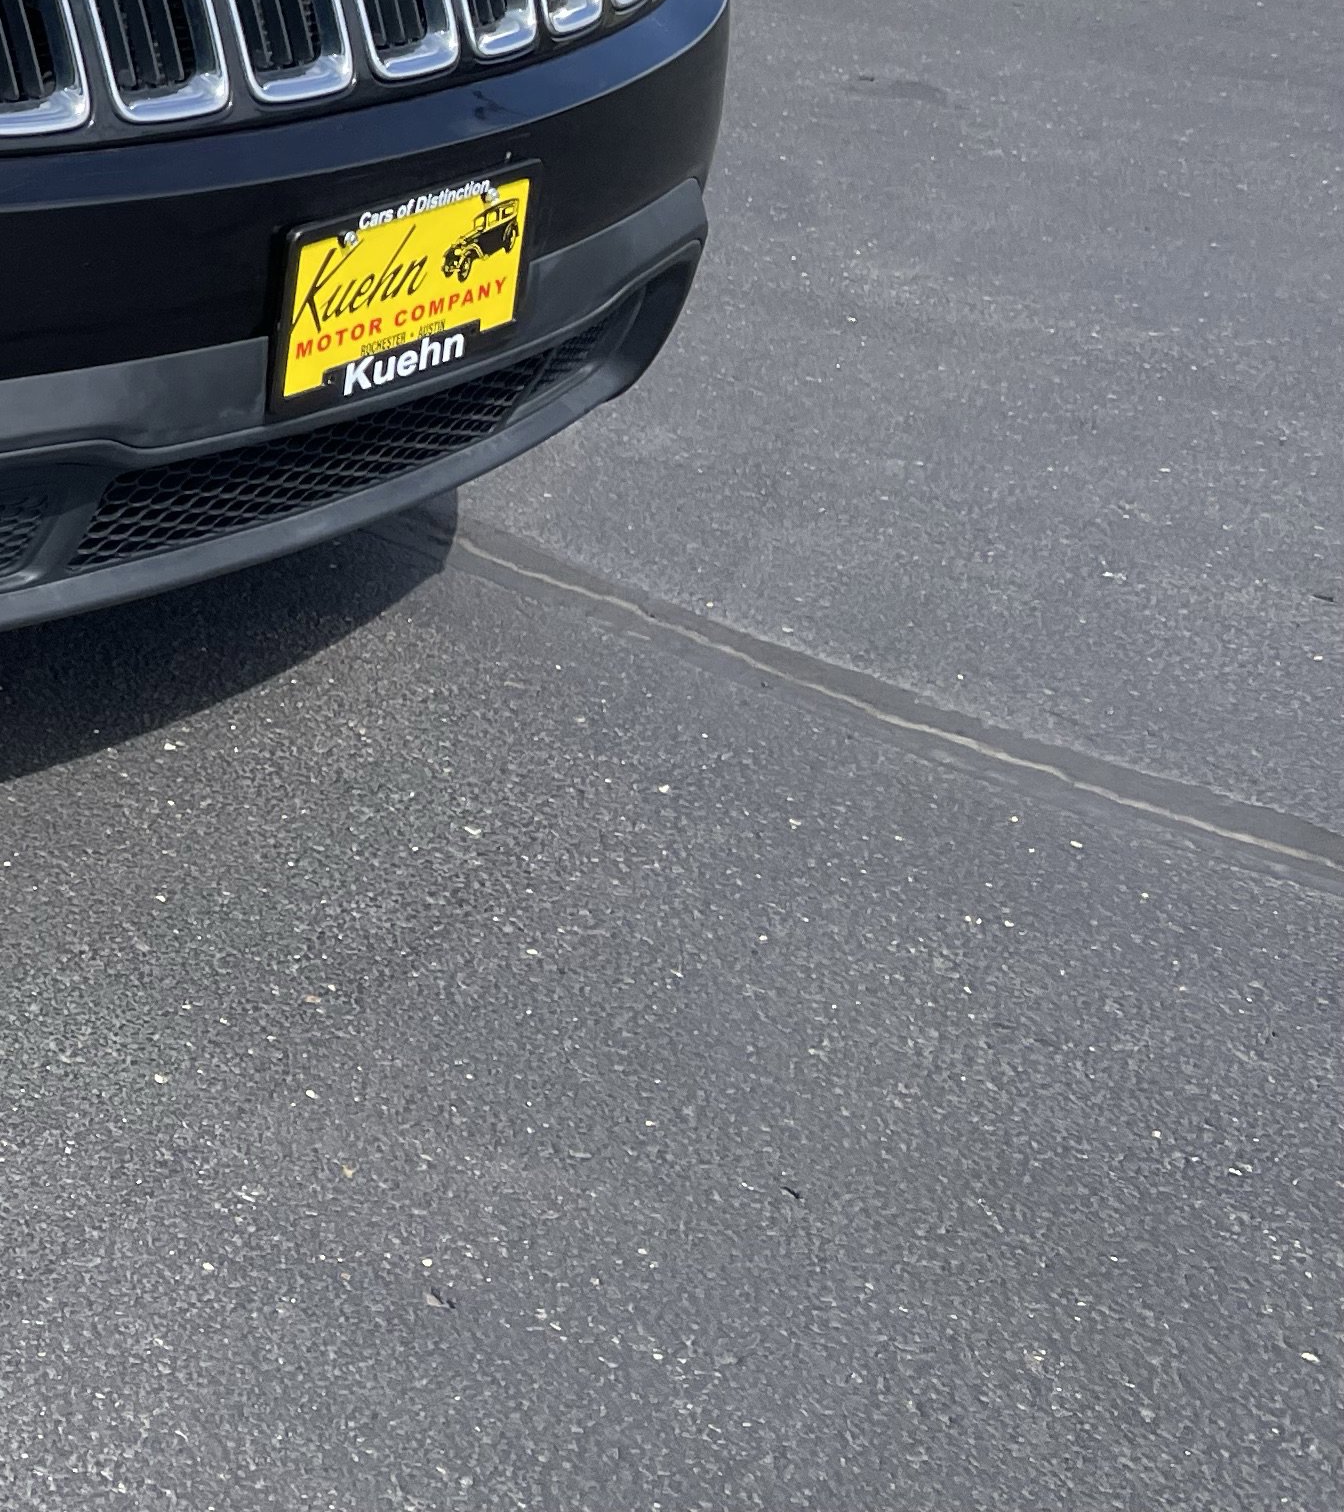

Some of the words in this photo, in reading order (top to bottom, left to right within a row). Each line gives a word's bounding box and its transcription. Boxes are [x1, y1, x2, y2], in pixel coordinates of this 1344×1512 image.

[359, 207, 394, 230] Cars
[396, 198, 416, 218] of
[414, 179, 491, 215] Distinction
[289, 223, 429, 334] Kuehn
[295, 317, 383, 361] MOTOR
[393, 275, 508, 328] COMPANY
[343, 332, 465, 397] Kuehn
